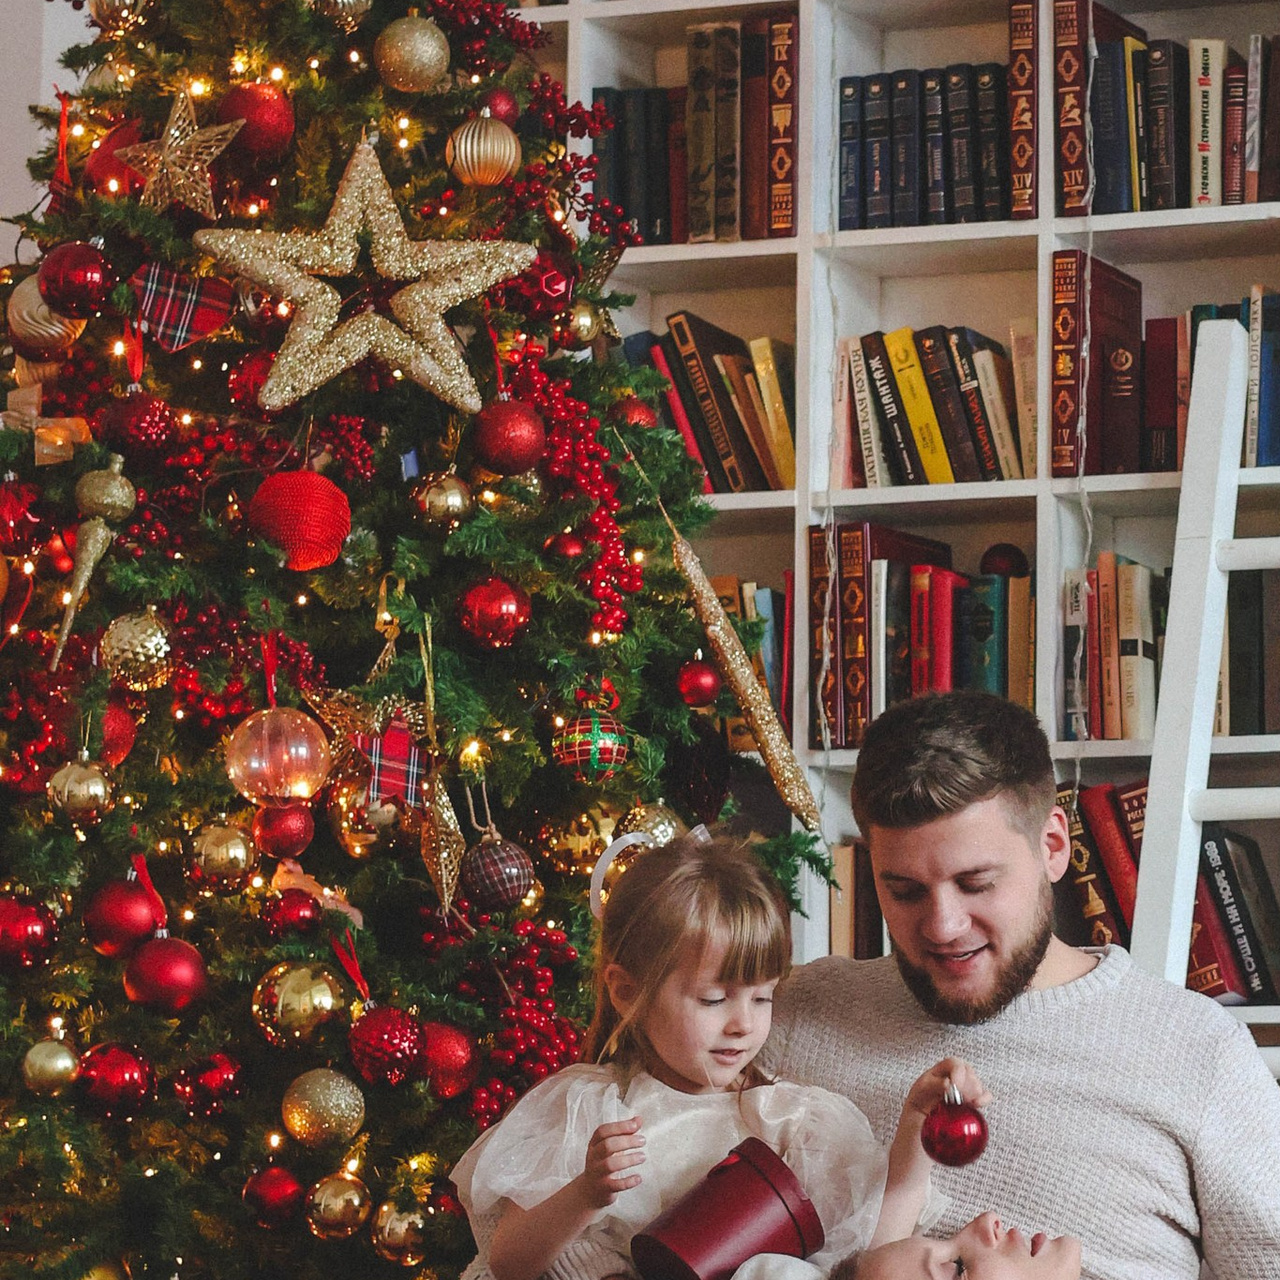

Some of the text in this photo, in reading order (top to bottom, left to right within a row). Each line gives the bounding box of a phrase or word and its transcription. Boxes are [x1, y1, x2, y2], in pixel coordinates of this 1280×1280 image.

[1249, 298, 1259, 369] ТОЛСТЯКА
[850, 348, 866, 394] КУХНЯ
[867, 355, 898, 419] ШАНТАЖ
[1213, 868, 1235, 905] МОРЕ
[1224, 903, 1241, 924] НА
[1231, 922, 1245, 936] И
[1235, 934, 1257, 973] СУШЕ
